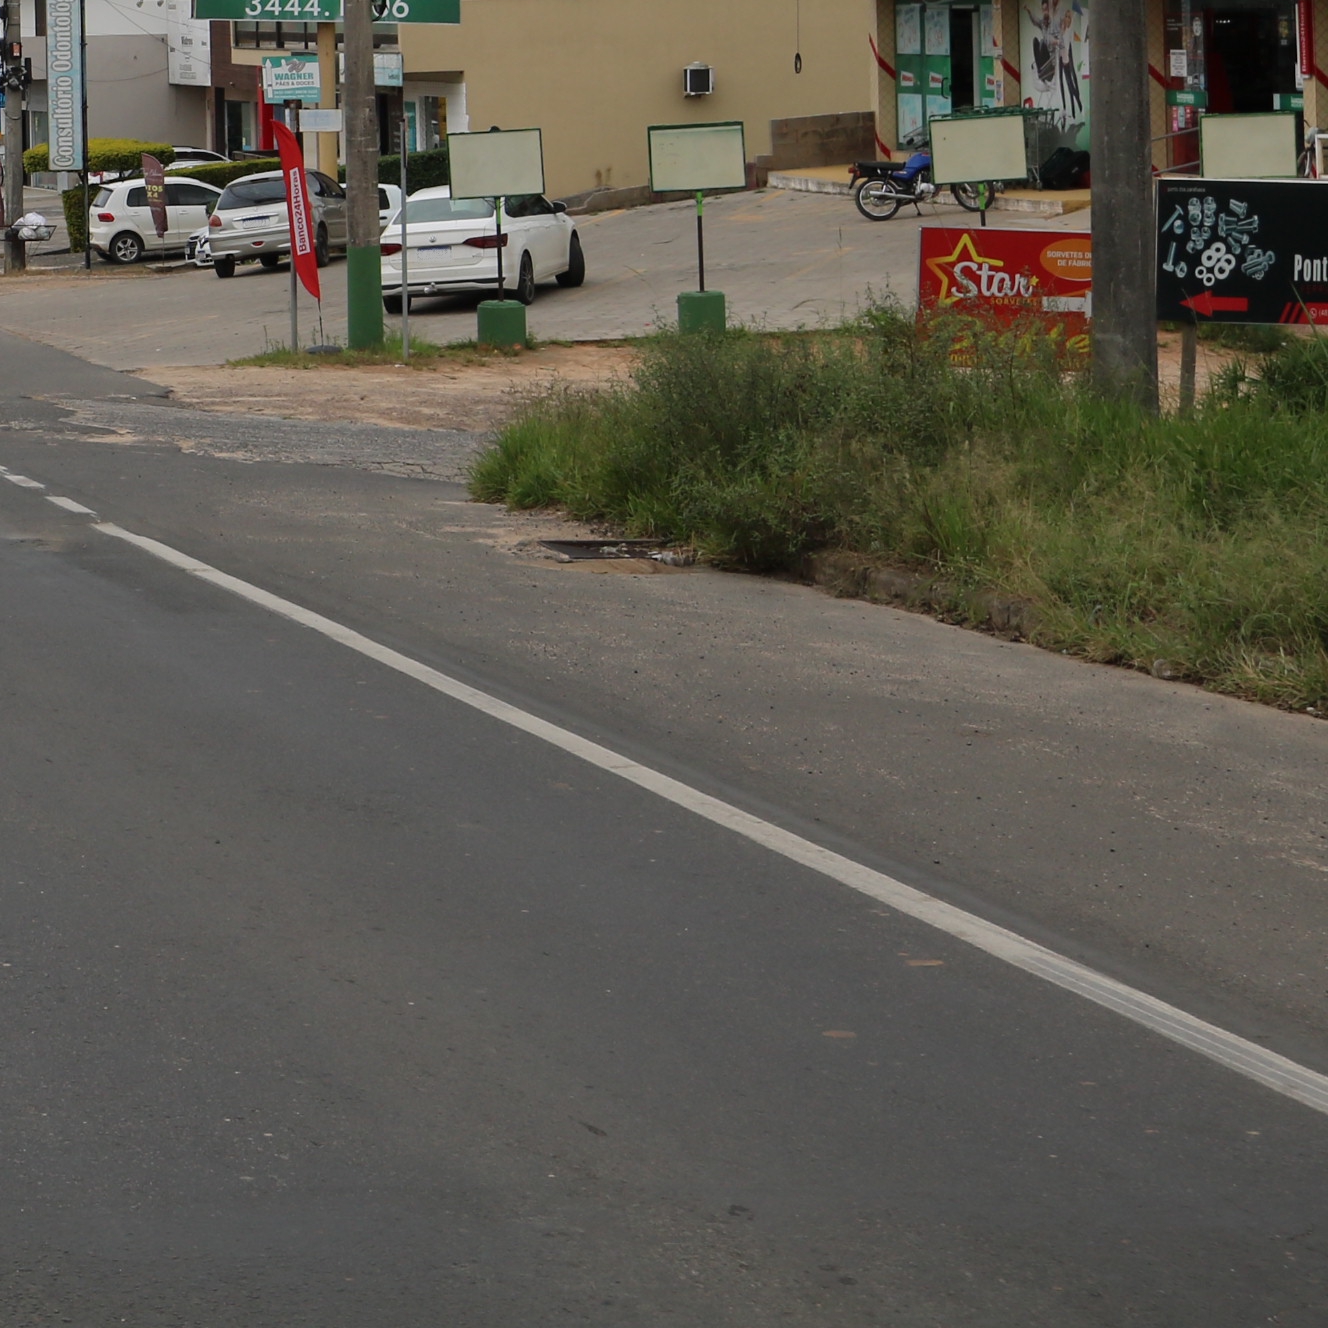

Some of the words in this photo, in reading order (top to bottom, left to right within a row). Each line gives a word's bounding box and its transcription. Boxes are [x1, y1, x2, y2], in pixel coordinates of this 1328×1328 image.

[274, 72, 314, 81] WAGNER
[52, 76, 75, 168] Consultório
[293, 170, 307, 253] Banco24Horas
[1047, 251, 1083, 259] SORVETES
[951, 261, 1034, 298] Star
